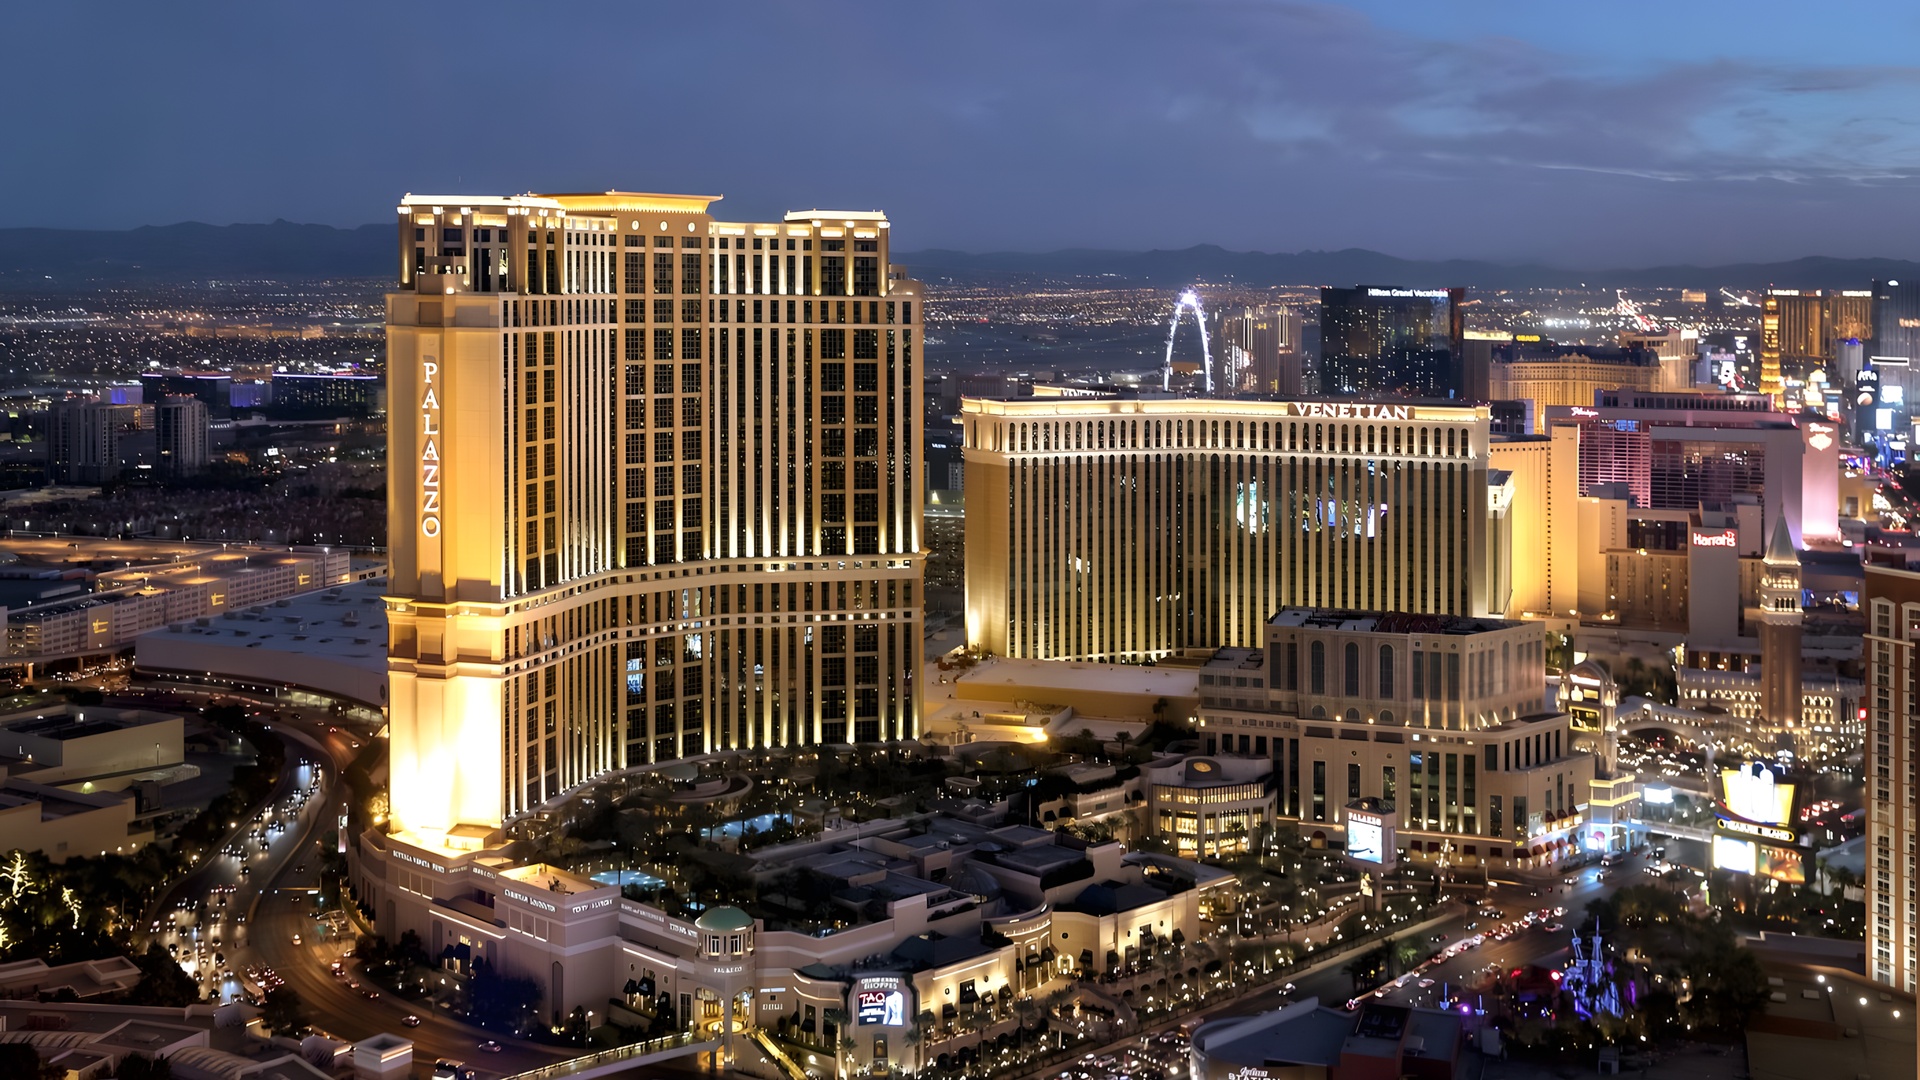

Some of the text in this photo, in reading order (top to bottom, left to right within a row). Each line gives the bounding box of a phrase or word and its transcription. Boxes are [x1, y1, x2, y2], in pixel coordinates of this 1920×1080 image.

[1368, 288, 1391, 297] Hilton
[1392, 288, 1414, 297] Grand
[1295, 402, 1410, 420] VENETIAN
[422, 362, 440, 537] PALAZZO
[1348, 812, 1382, 826] PALAZZO
[859, 992, 886, 1006] TAO
